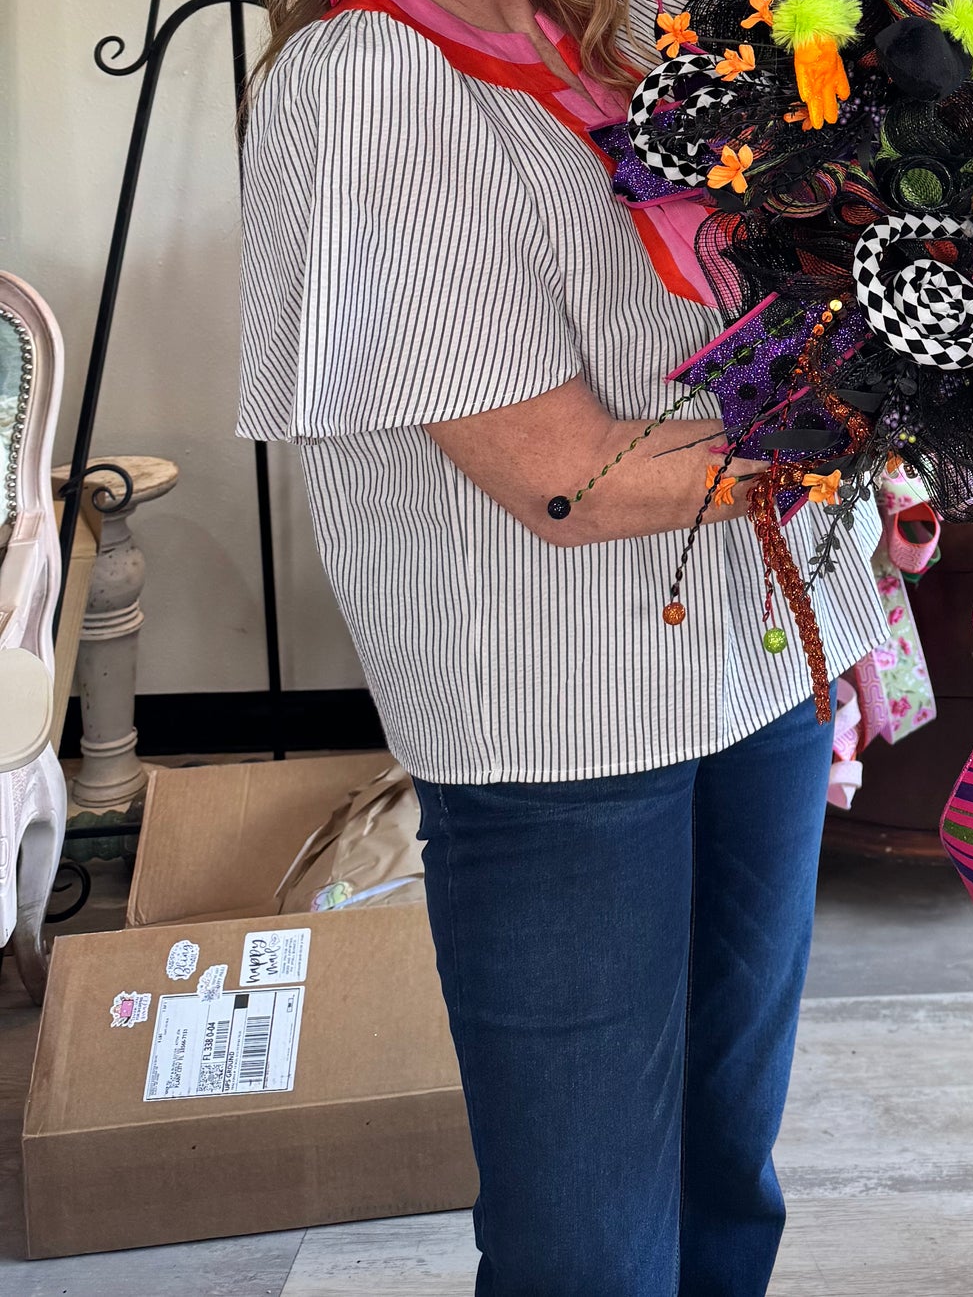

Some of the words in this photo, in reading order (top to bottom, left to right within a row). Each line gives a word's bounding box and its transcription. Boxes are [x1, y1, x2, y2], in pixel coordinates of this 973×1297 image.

[246, 939, 268, 983] happy
[265, 947, 281, 975] mail
[206, 1022, 216, 1037] 0-04
[204, 1038, 214, 1051] 338
[202, 1052, 212, 1061] FL
[226, 1051, 235, 1078] GROUND
